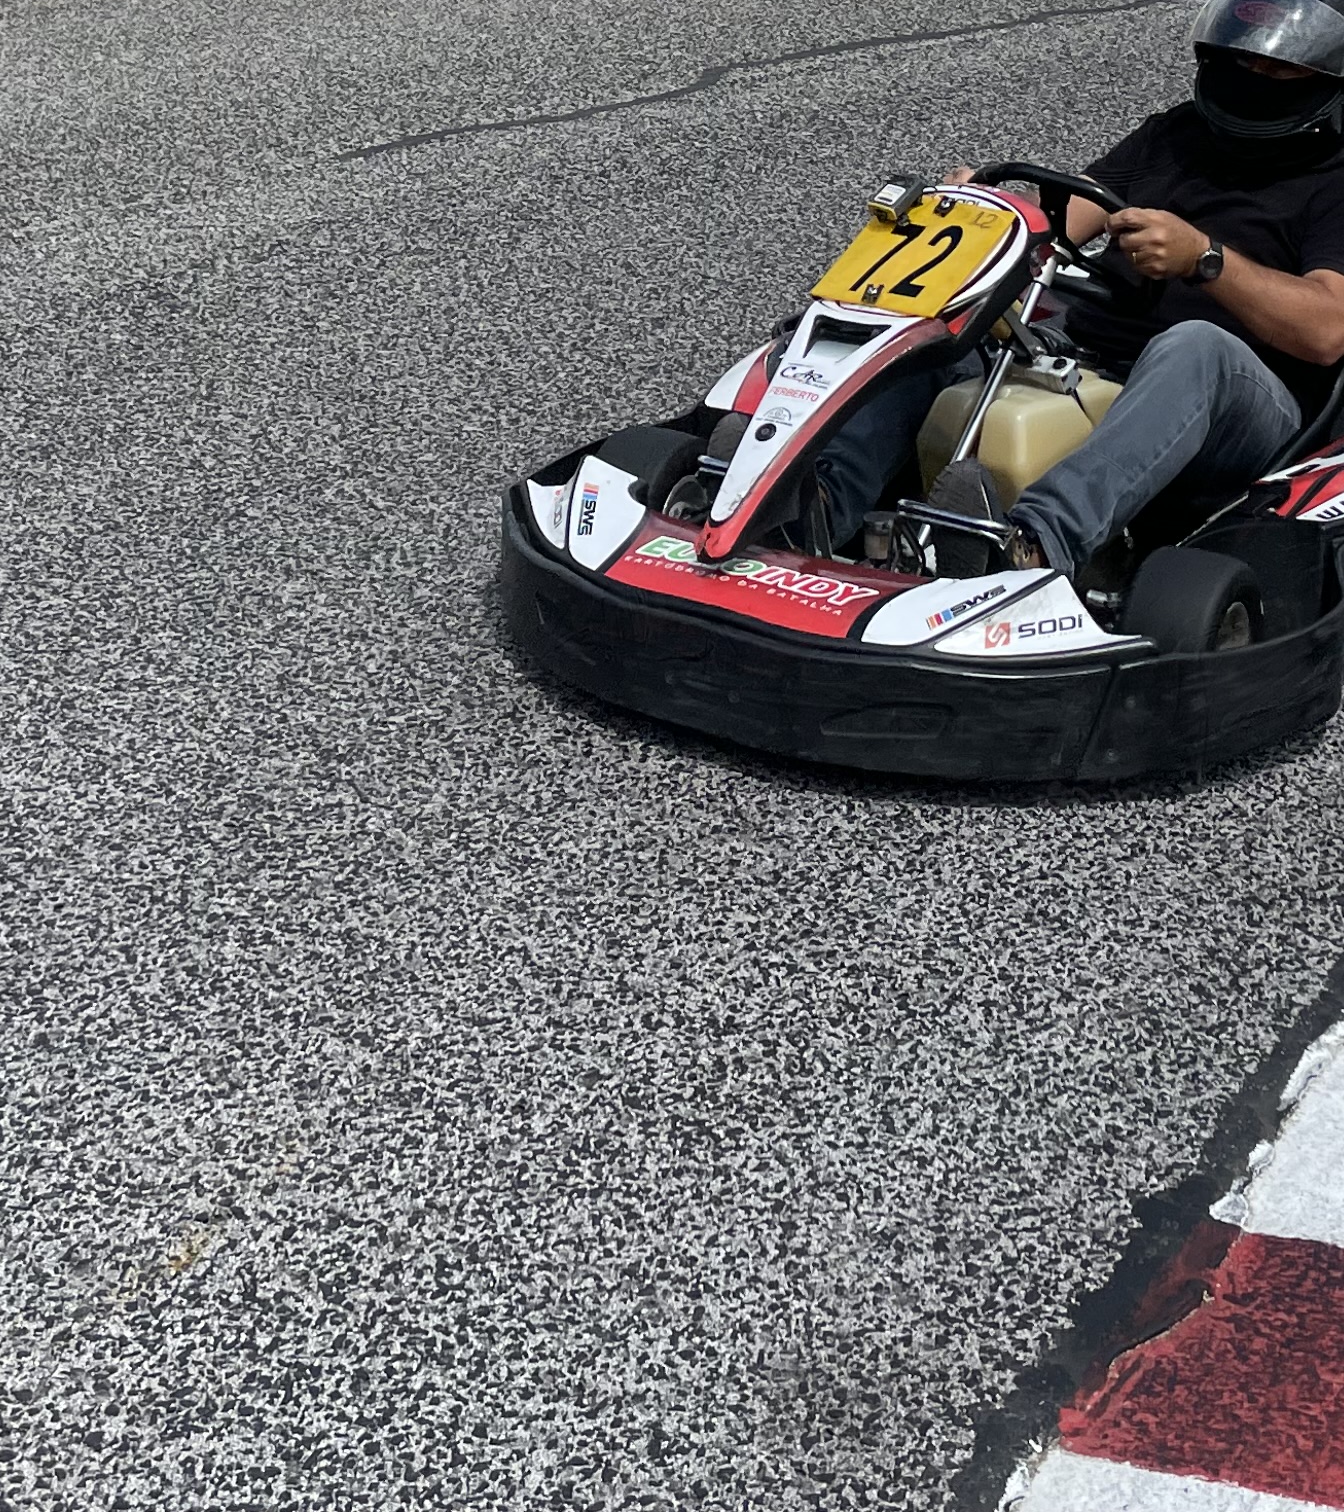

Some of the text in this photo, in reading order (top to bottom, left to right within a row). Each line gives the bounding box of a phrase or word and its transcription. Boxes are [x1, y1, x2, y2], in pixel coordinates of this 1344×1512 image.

[848, 223, 964, 298] 72
[577, 499, 597, 536] SWS
[634, 535, 881, 606] EUOINDY
[950, 584, 1007, 618] SWS
